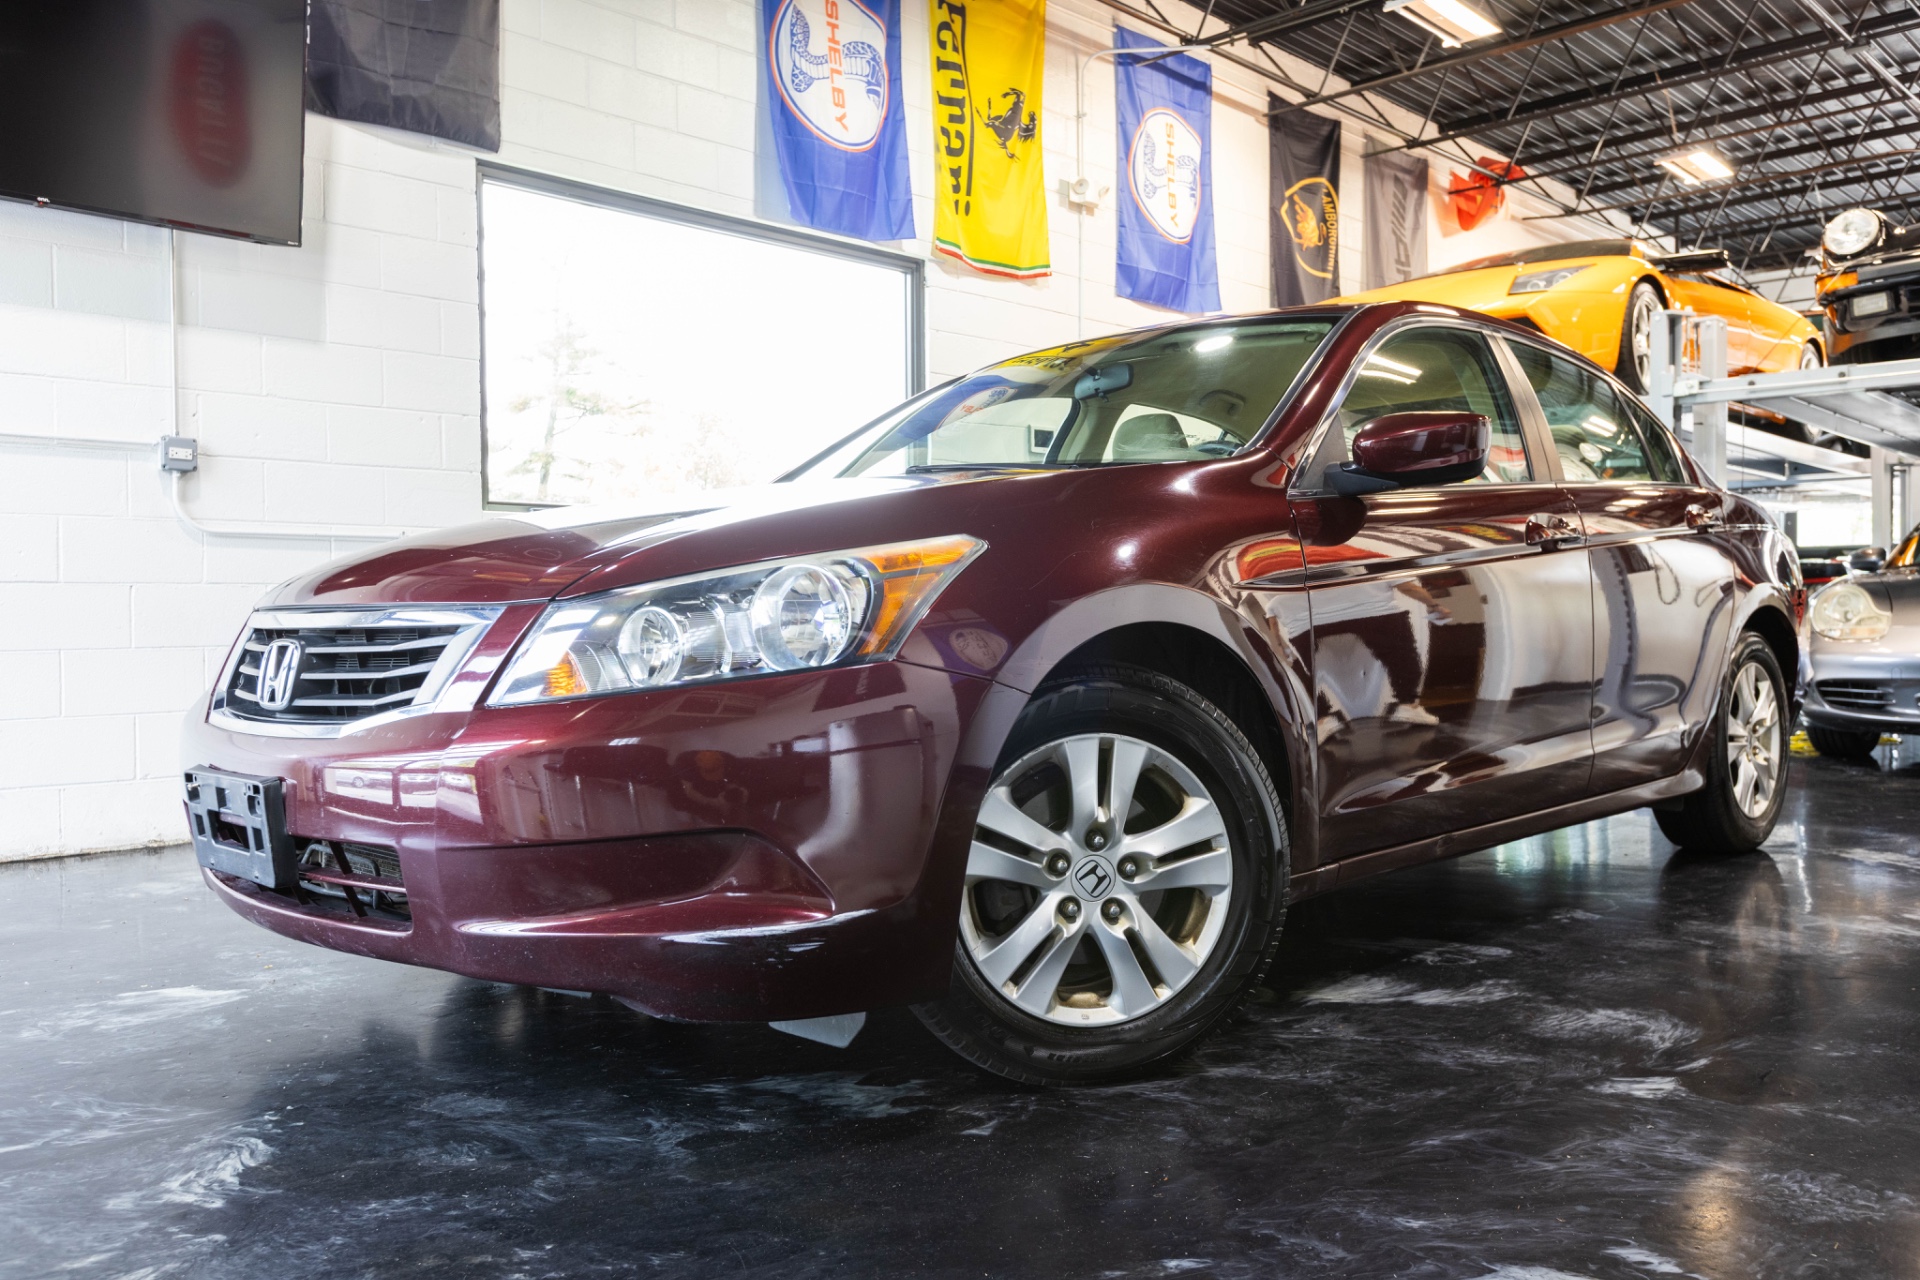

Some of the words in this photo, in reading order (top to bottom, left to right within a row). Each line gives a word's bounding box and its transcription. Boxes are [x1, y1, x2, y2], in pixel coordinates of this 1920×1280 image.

[825, 0, 849, 132] SHELBY
[1165, 122, 1179, 228] SHELBY
[1322, 187, 1338, 271] LAMBORGHINI
